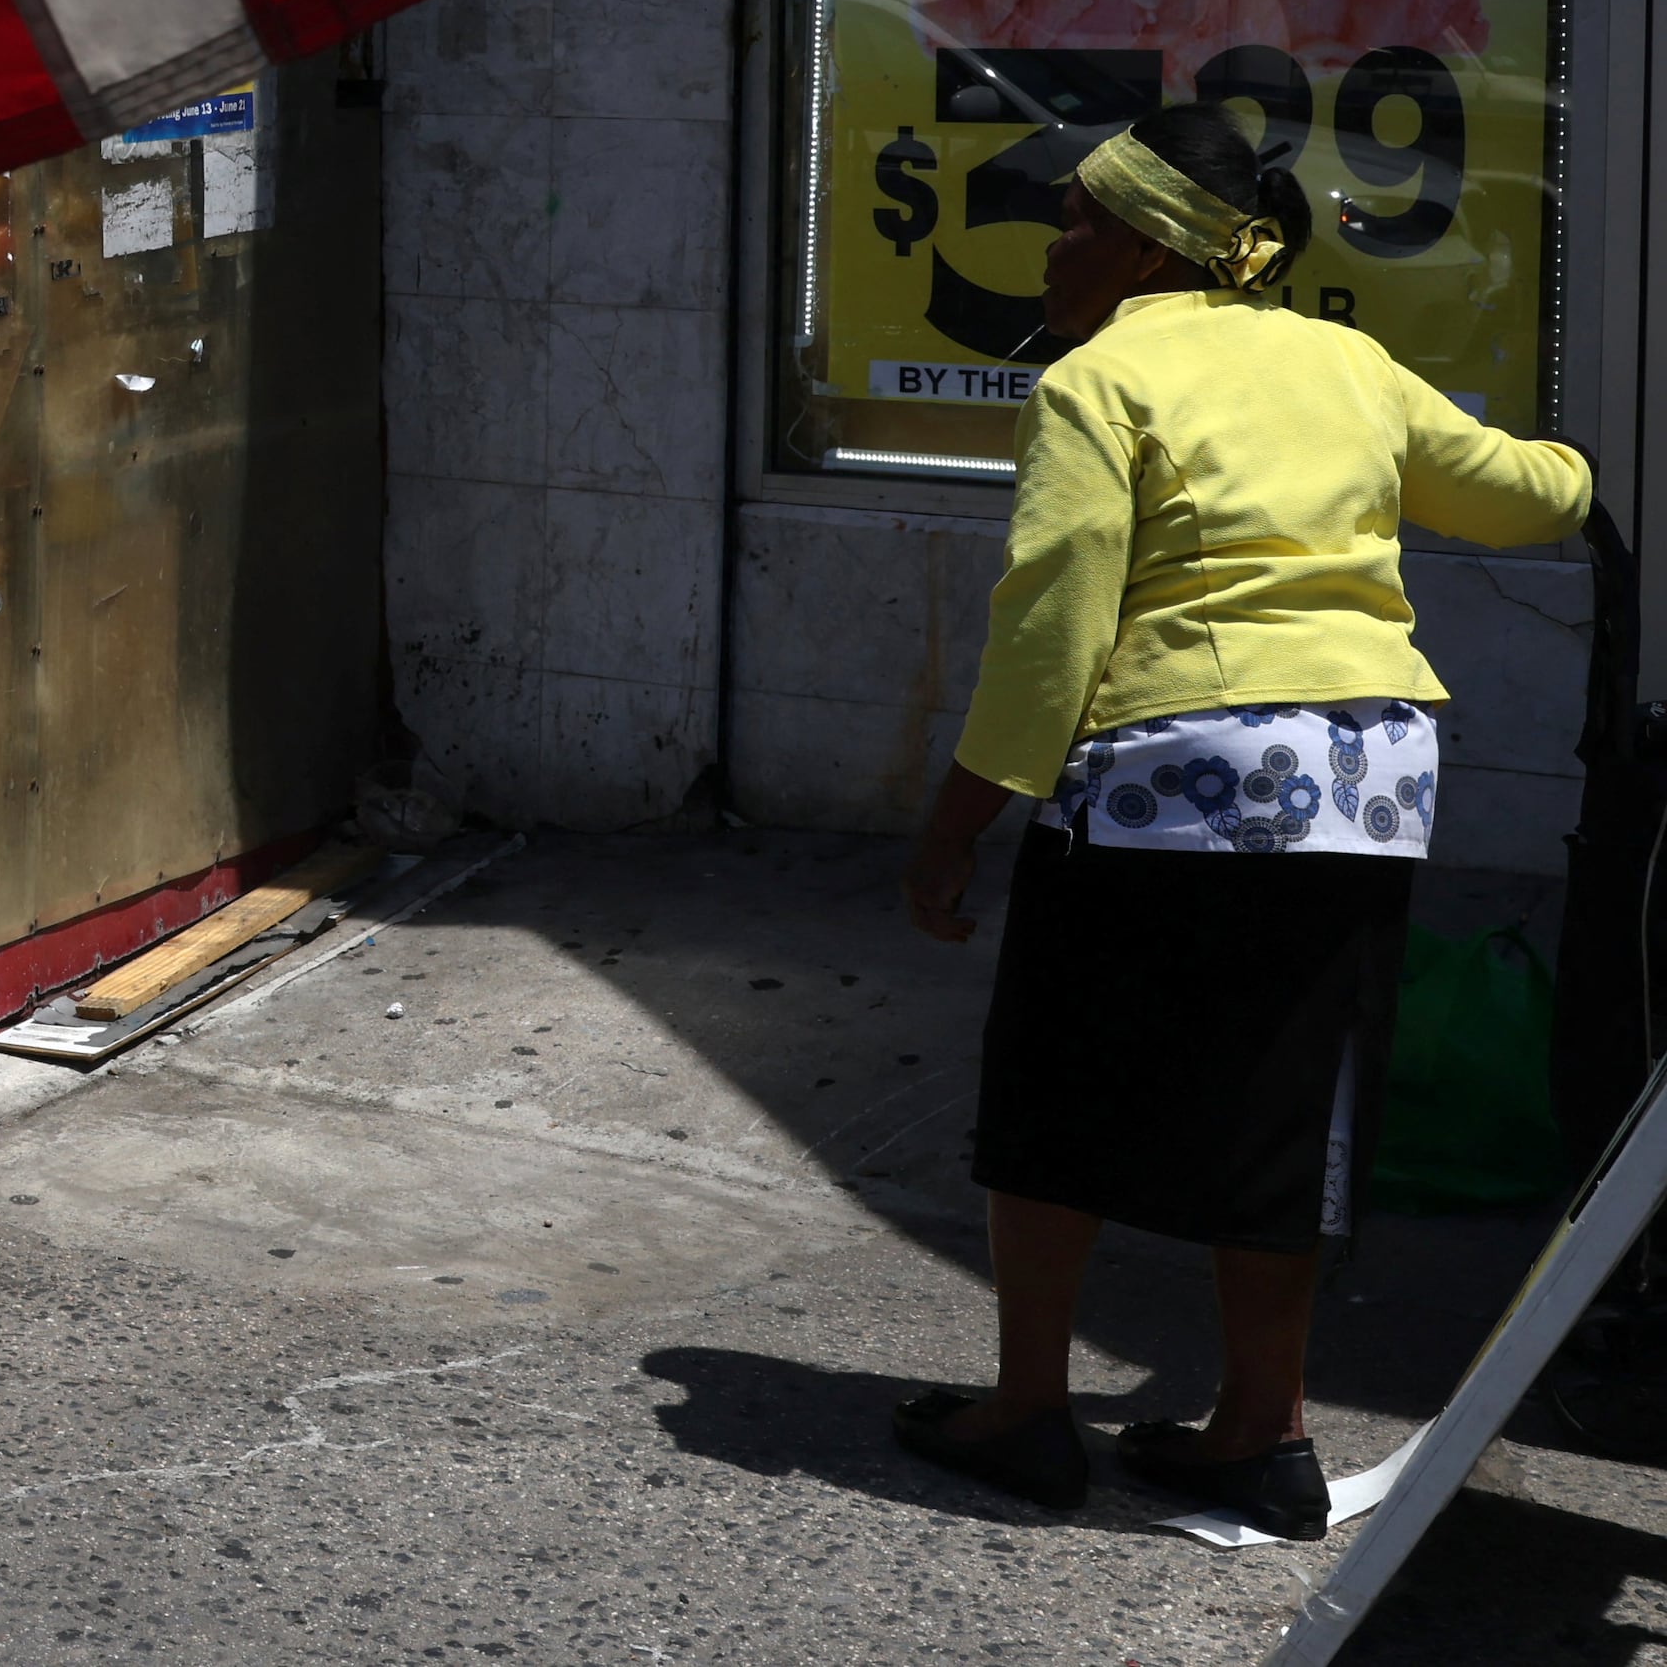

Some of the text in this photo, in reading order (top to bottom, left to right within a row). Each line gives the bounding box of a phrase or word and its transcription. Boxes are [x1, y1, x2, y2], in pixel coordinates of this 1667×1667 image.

[201, 102, 213, 115] 13
[219, 100, 238, 114] June
[899, 366, 1030, 400] BY THE
